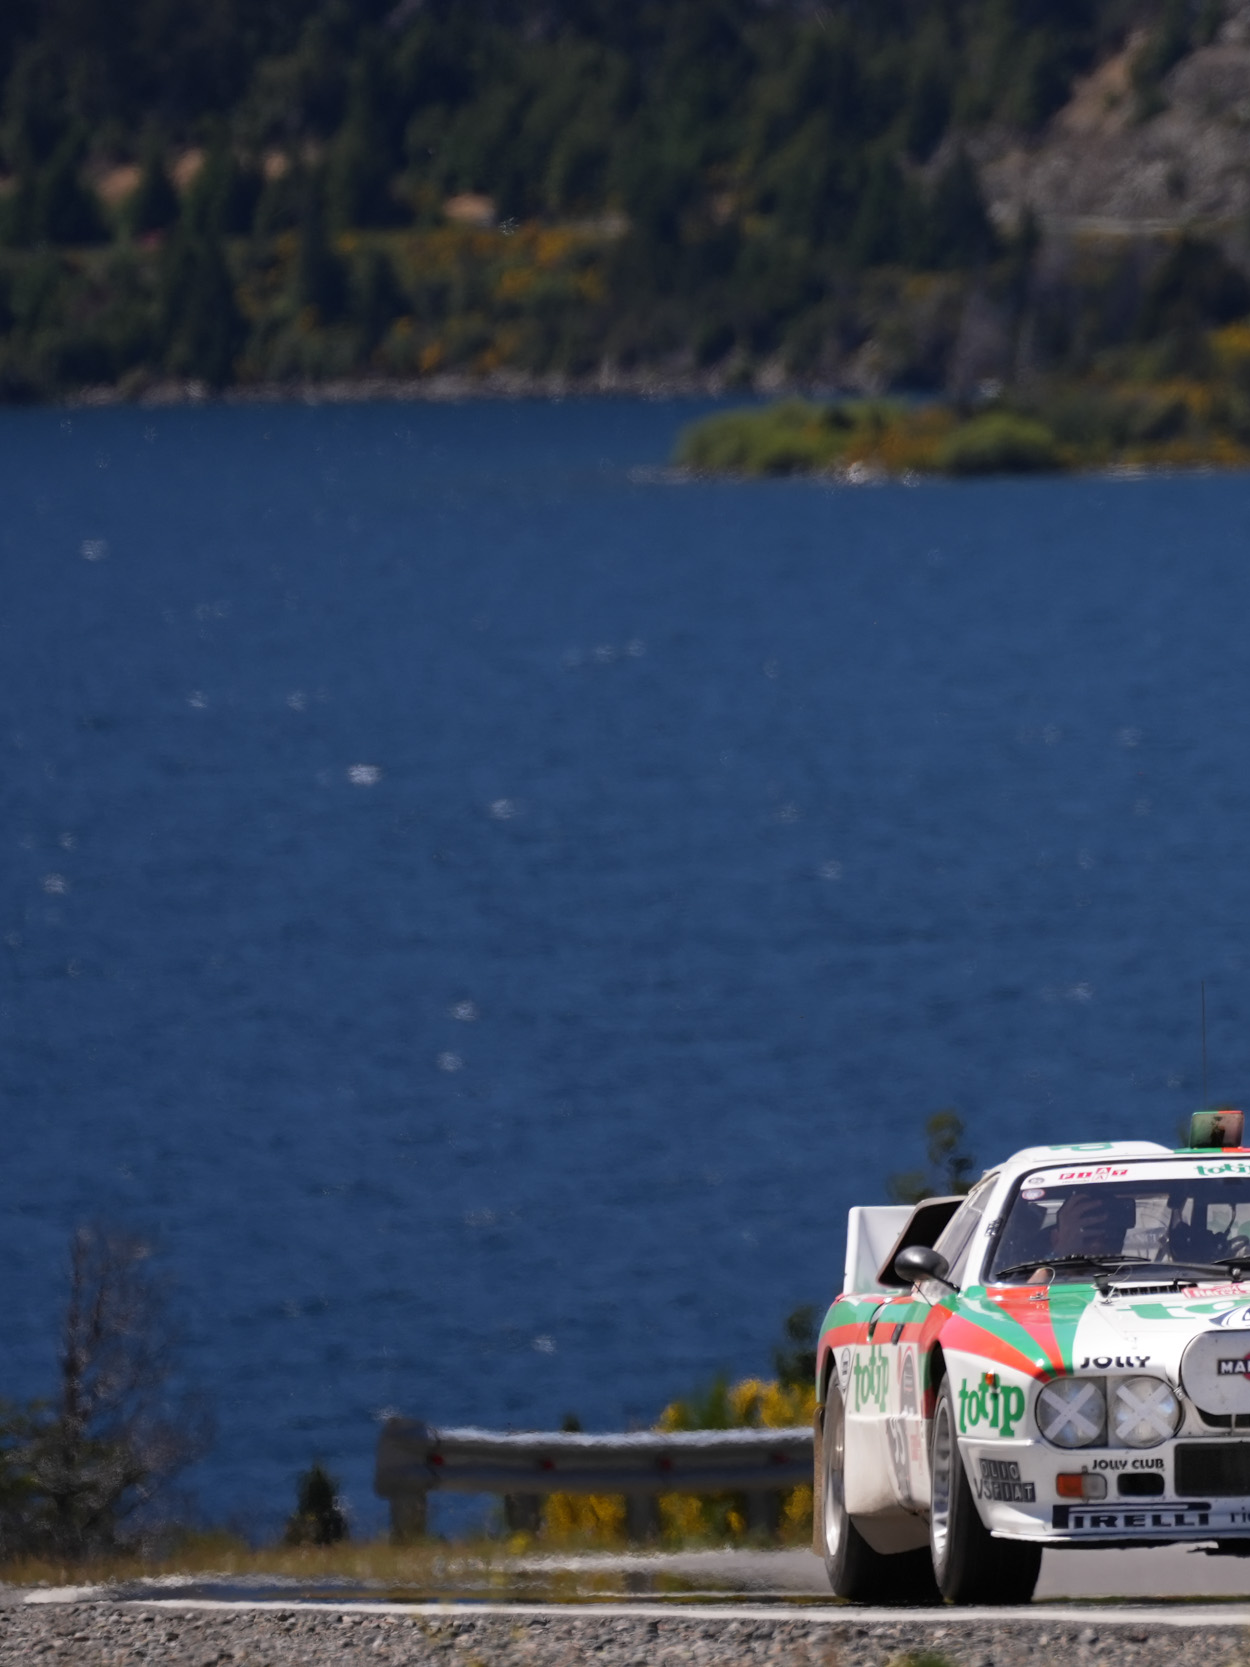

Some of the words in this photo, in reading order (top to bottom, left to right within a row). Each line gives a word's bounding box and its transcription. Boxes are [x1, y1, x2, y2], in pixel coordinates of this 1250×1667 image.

[1080, 1356, 1151, 1369] JOLLY
[854, 1344, 889, 1413] totip
[958, 1372, 1026, 1437] totip
[1092, 1459, 1127, 1471] JOLLY
[1132, 1458, 1164, 1470] CLUB
[1052, 1502, 1211, 1529] PIRELLI
